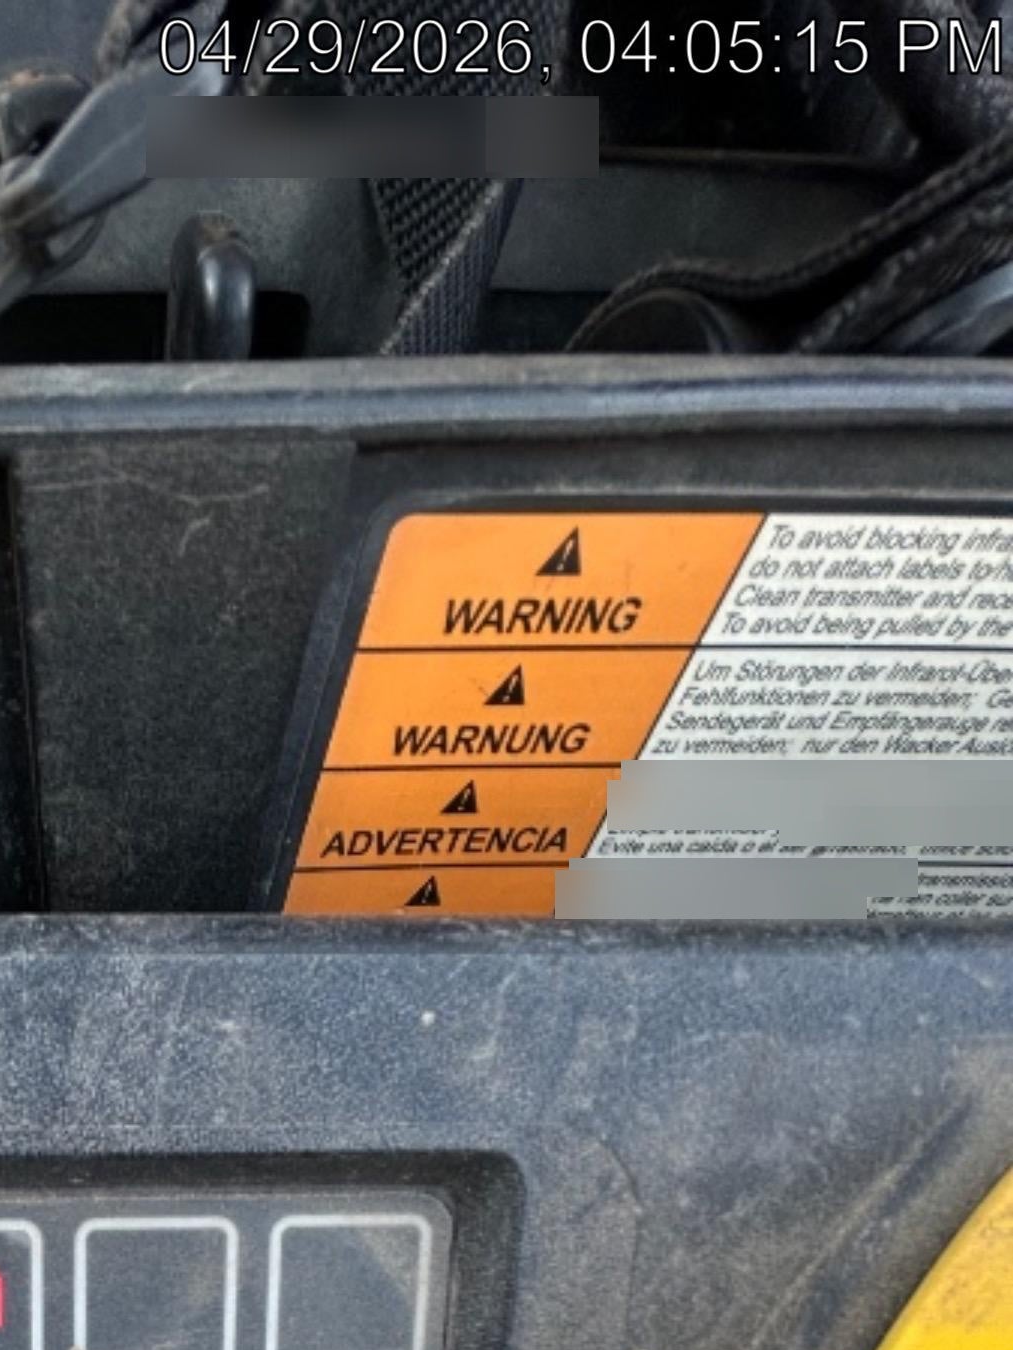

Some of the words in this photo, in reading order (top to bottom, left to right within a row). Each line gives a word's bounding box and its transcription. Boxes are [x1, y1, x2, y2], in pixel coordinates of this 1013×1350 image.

[769, 524, 795, 550] To
[798, 525, 864, 550] avoid
[865, 525, 960, 556] blocking
[749, 555, 779, 579] do
[782, 557, 823, 579] not
[824, 556, 894, 580] attach
[897, 556, 966, 580] labels
[735, 584, 800, 607] Clean
[802, 584, 923, 608] transmitter
[921, 582, 972, 609] and
[443, 596, 642, 635] WARNING
[721, 611, 748, 635] To
[749, 611, 811, 635] avoid
[812, 612, 876, 640] being
[873, 611, 945, 640] pulled
[944, 613, 979, 642] by
[694, 659, 733, 682] Um
[735, 659, 848, 686] Störungen
[847, 662, 888, 682] der
[679, 686, 833, 707] Fehlfunktionen
[831, 690, 863, 706] zu
[666, 710, 787, 735] Sendegerät
[787, 711, 830, 731] und
[829, 710, 989, 738] Empfängerauge
[392, 722, 591, 757] WARNUNG
[651, 738, 683, 755] zu
[801, 738, 839, 754] nur
[838, 736, 879, 754] den
[884, 735, 959, 756] Wacker
[321, 826, 568, 858] ADVERTENCIA
